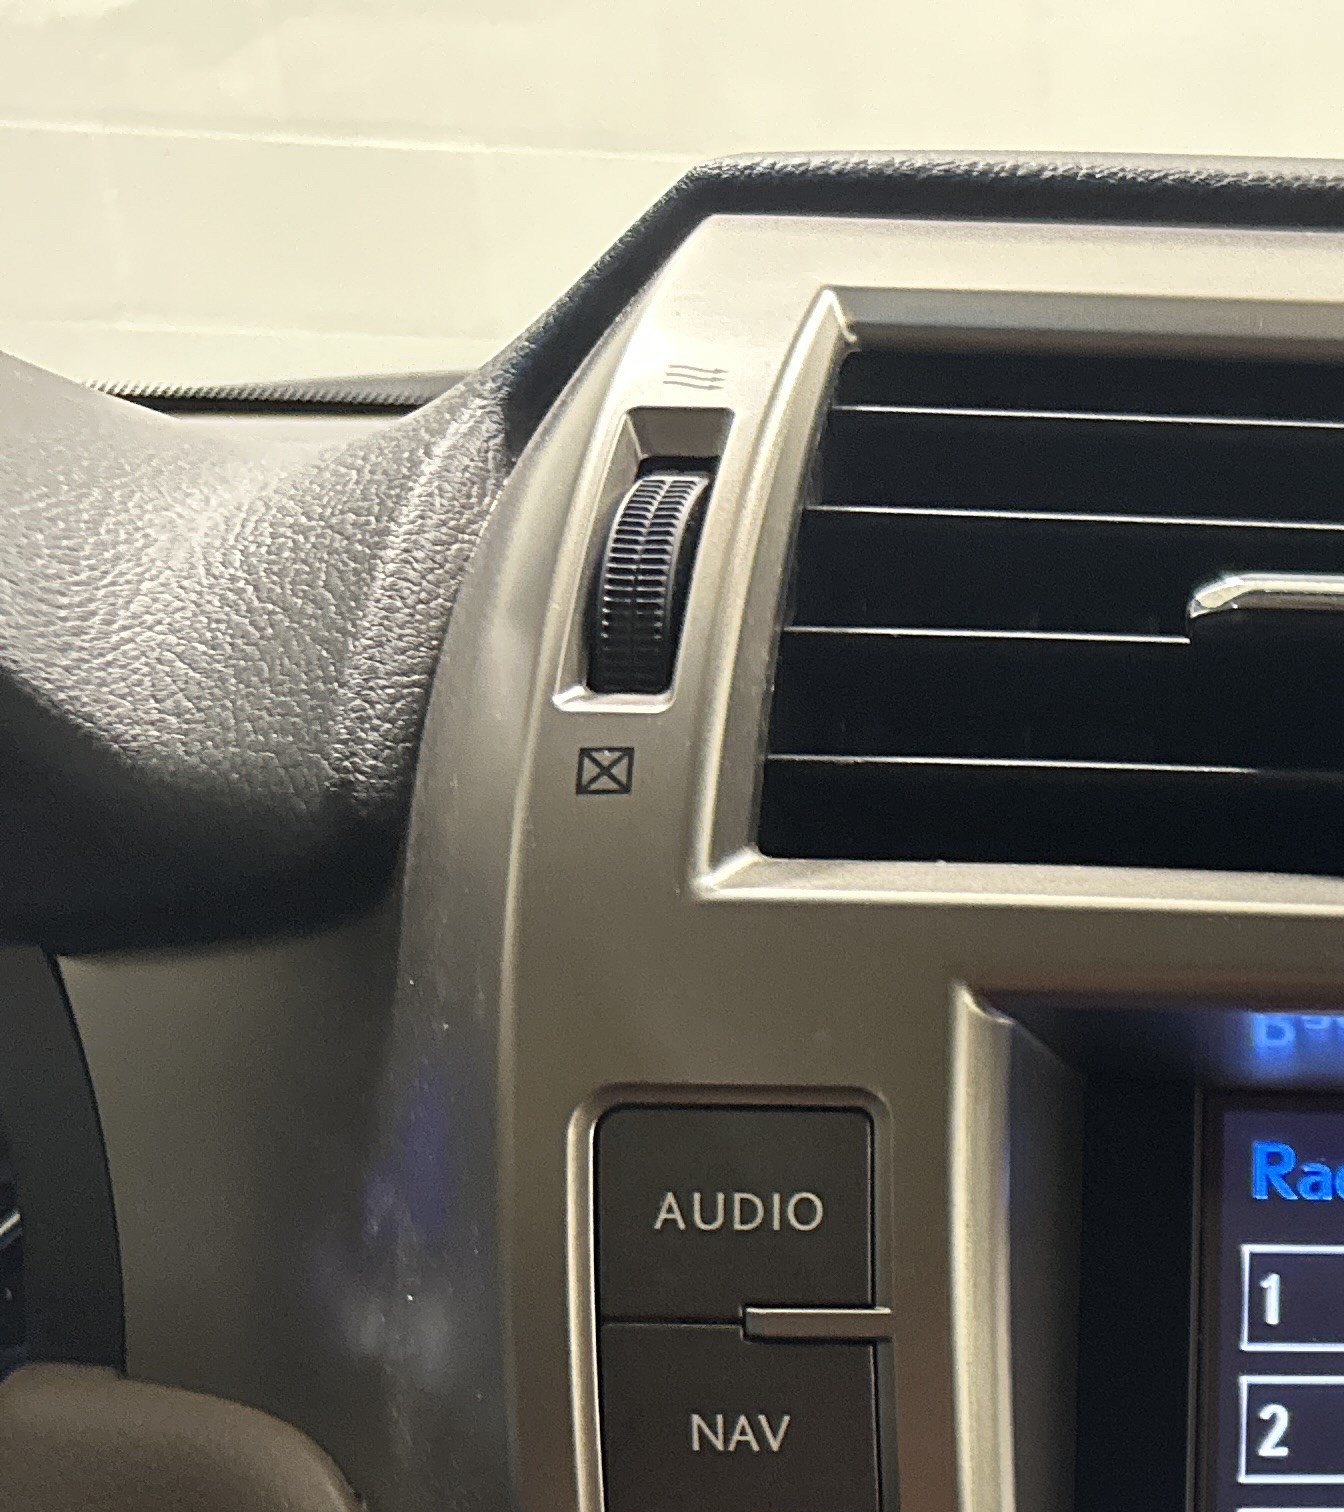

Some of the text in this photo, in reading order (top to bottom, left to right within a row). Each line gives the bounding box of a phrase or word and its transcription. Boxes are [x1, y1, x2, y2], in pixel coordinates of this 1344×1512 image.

[653, 1190, 825, 1232] AUDIO
[1259, 1272, 1282, 1326] 1
[690, 1413, 793, 1453] NAV
[1256, 1402, 1291, 1458] 2
